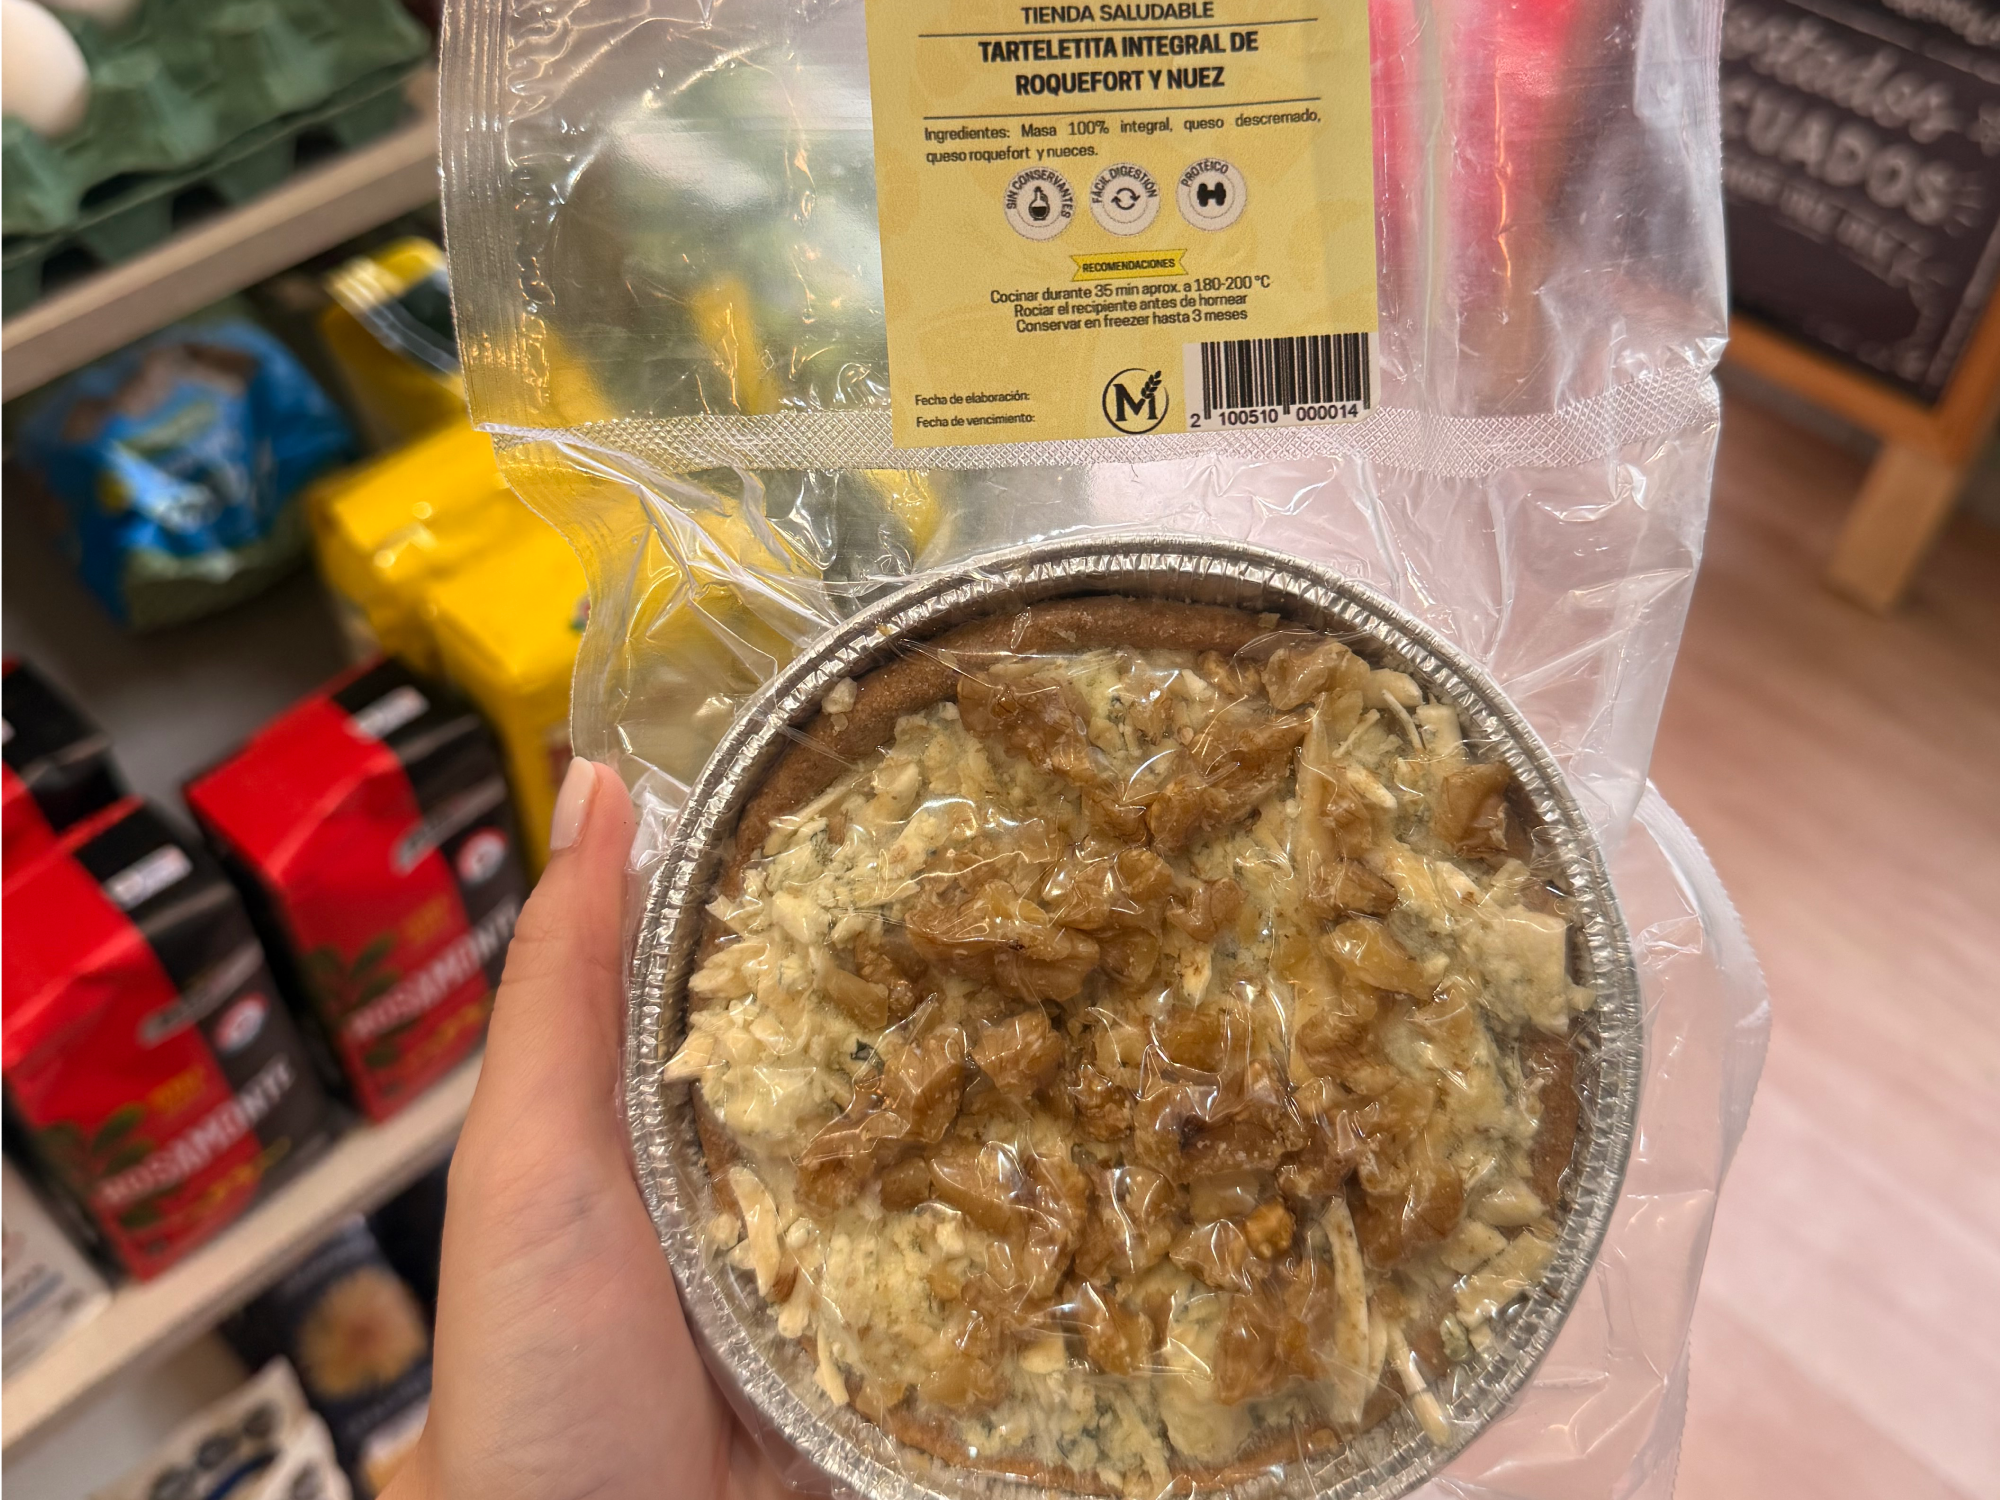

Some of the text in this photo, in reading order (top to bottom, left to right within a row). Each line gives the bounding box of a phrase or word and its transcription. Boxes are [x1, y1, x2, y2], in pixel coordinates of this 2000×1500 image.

[1021, 1, 1214, 24] TIENDA SALUDABLE
[979, 31, 1259, 62] TARTELETITA INTEGRAL DE
[1015, 66, 1225, 96] ROQUEFORT Y NUEZ
[924, 108, 1321, 144] Ingredientes: Masa 100% integral, queso descremado,
[926, 145, 1099, 166] queso roquefort y nueces.
[1006, 168, 1074, 219] SIN CONSERVANTES
[1082, 258, 1175, 273] RECOMENDACIONES
[990, 275, 1271, 304] Cocinar durante 35 min aprox. a 180-200 °C
[1014, 293, 1248, 318] Rociar el recipiente antes de hornear
[1016, 308, 1248, 333] Conservar en freezer hasta 3 meses
[914, 390, 1030, 406] Fecha de elaboración:
[916, 413, 1035, 428] Fecha de vencimiento:
[1190, 404, 1359, 428] 2 100510 000014
